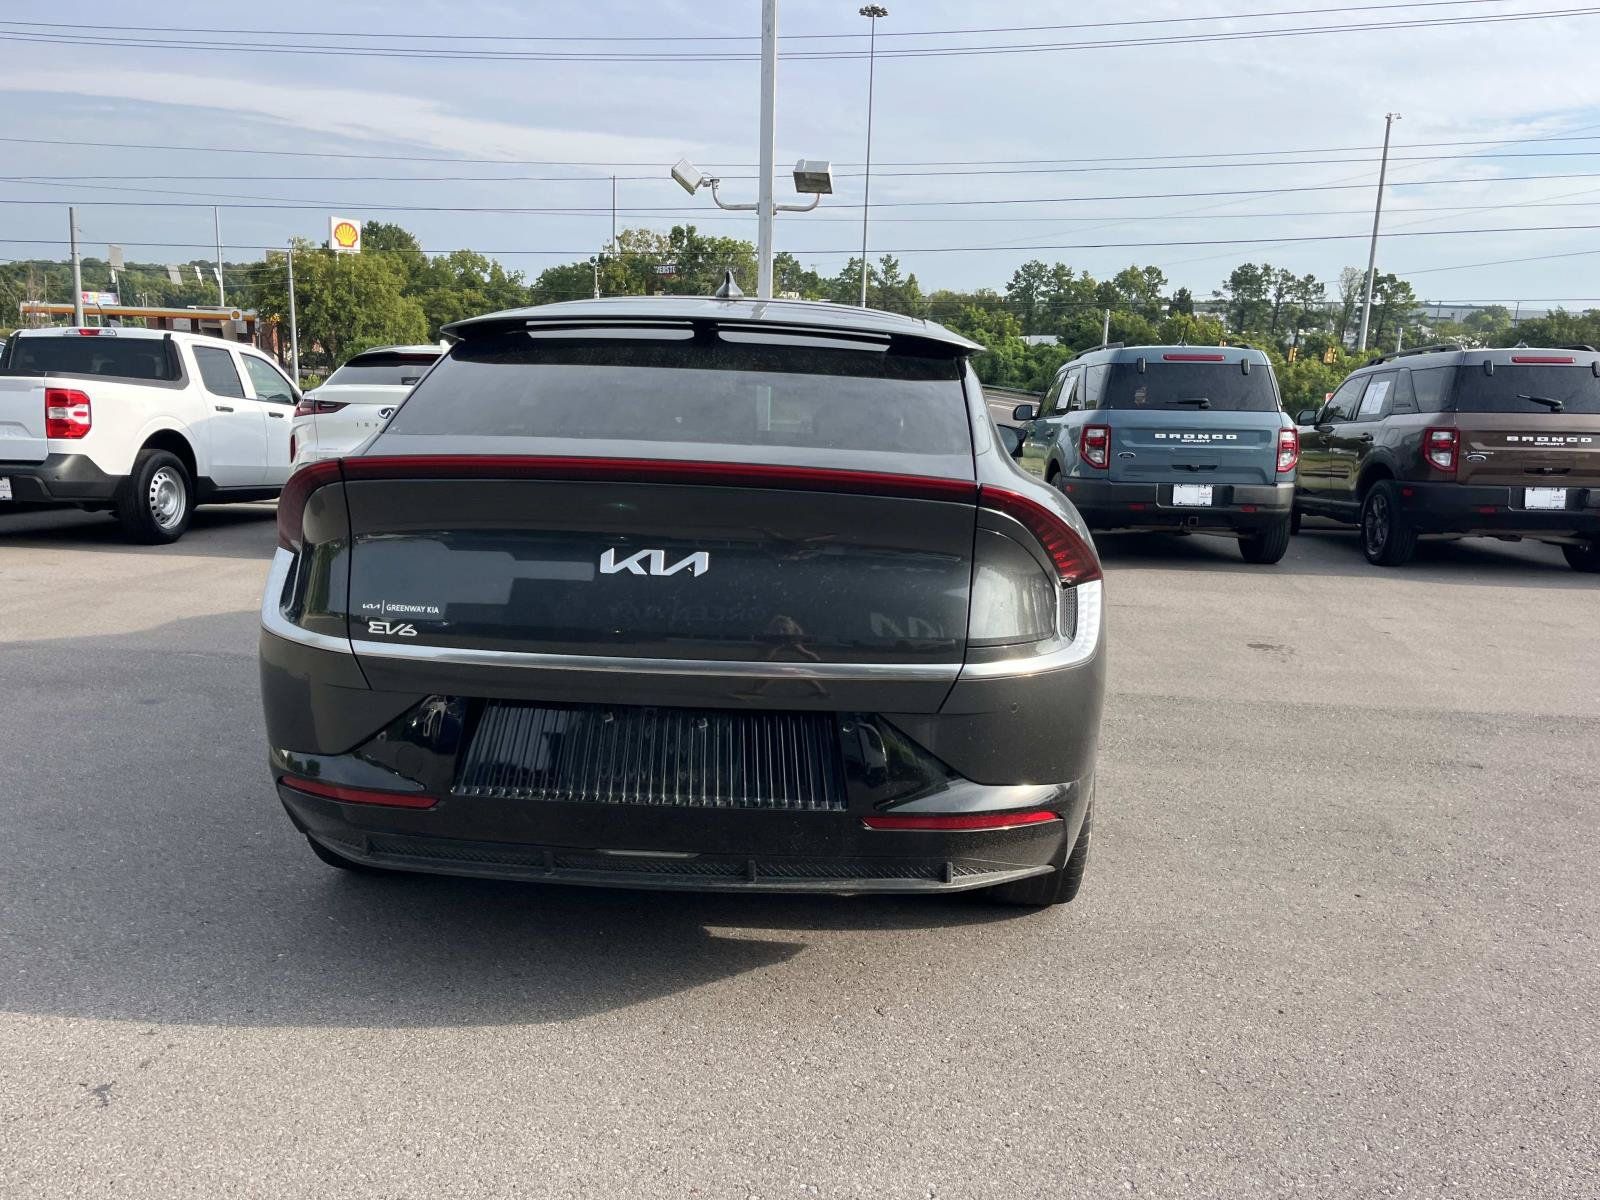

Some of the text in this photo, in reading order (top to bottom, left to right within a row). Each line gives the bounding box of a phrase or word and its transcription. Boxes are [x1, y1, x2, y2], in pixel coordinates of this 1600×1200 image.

[1506, 435, 1592, 443] BRONCO
[600, 548, 709, 577] KIA
[386, 604, 425, 613] GREENWAY
[426, 606, 440, 614] KIA
[368, 621, 418, 636] EV6
